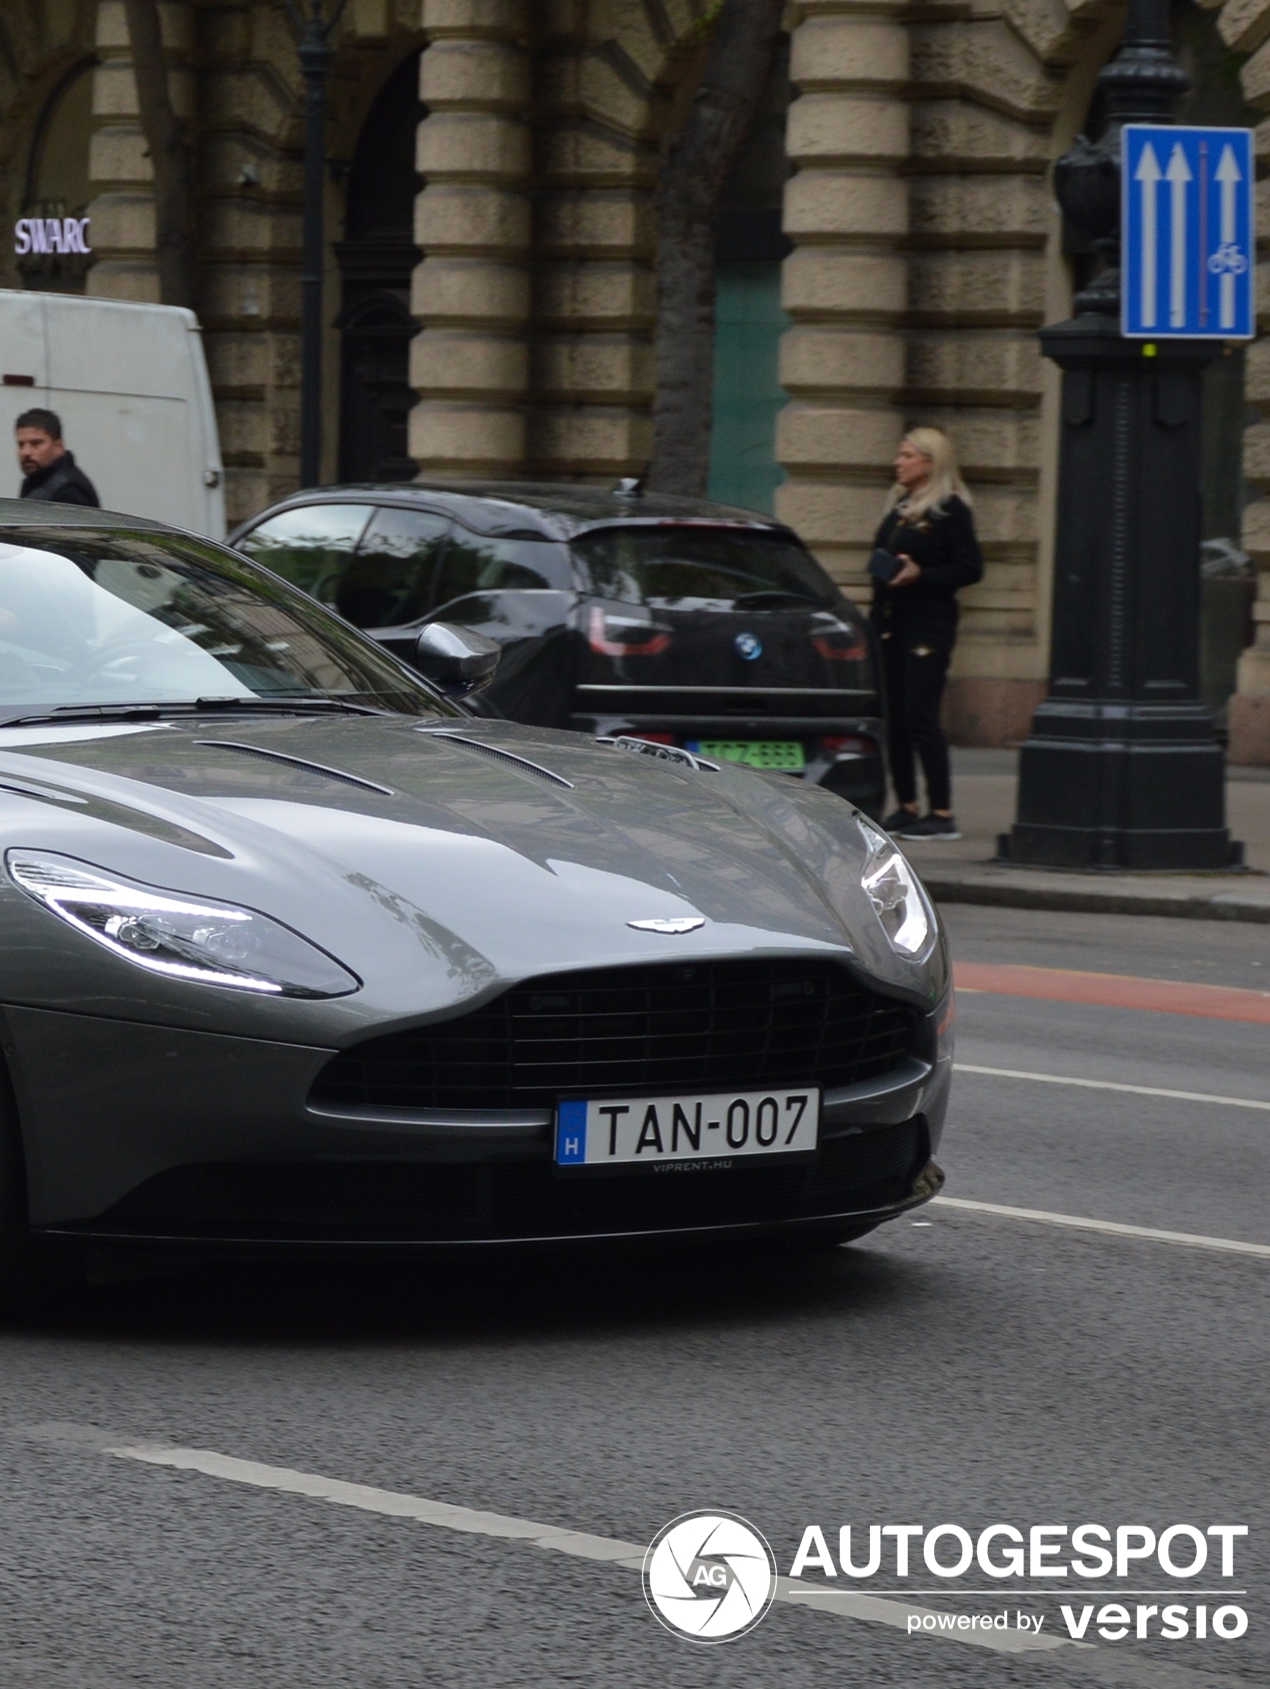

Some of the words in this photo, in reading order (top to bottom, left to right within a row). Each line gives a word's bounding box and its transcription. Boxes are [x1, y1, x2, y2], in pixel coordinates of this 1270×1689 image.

[564, 1137, 579, 1156] H
[598, 1095, 808, 1156] TAN-007
[653, 1160, 733, 1173] VIPRENT.HU
